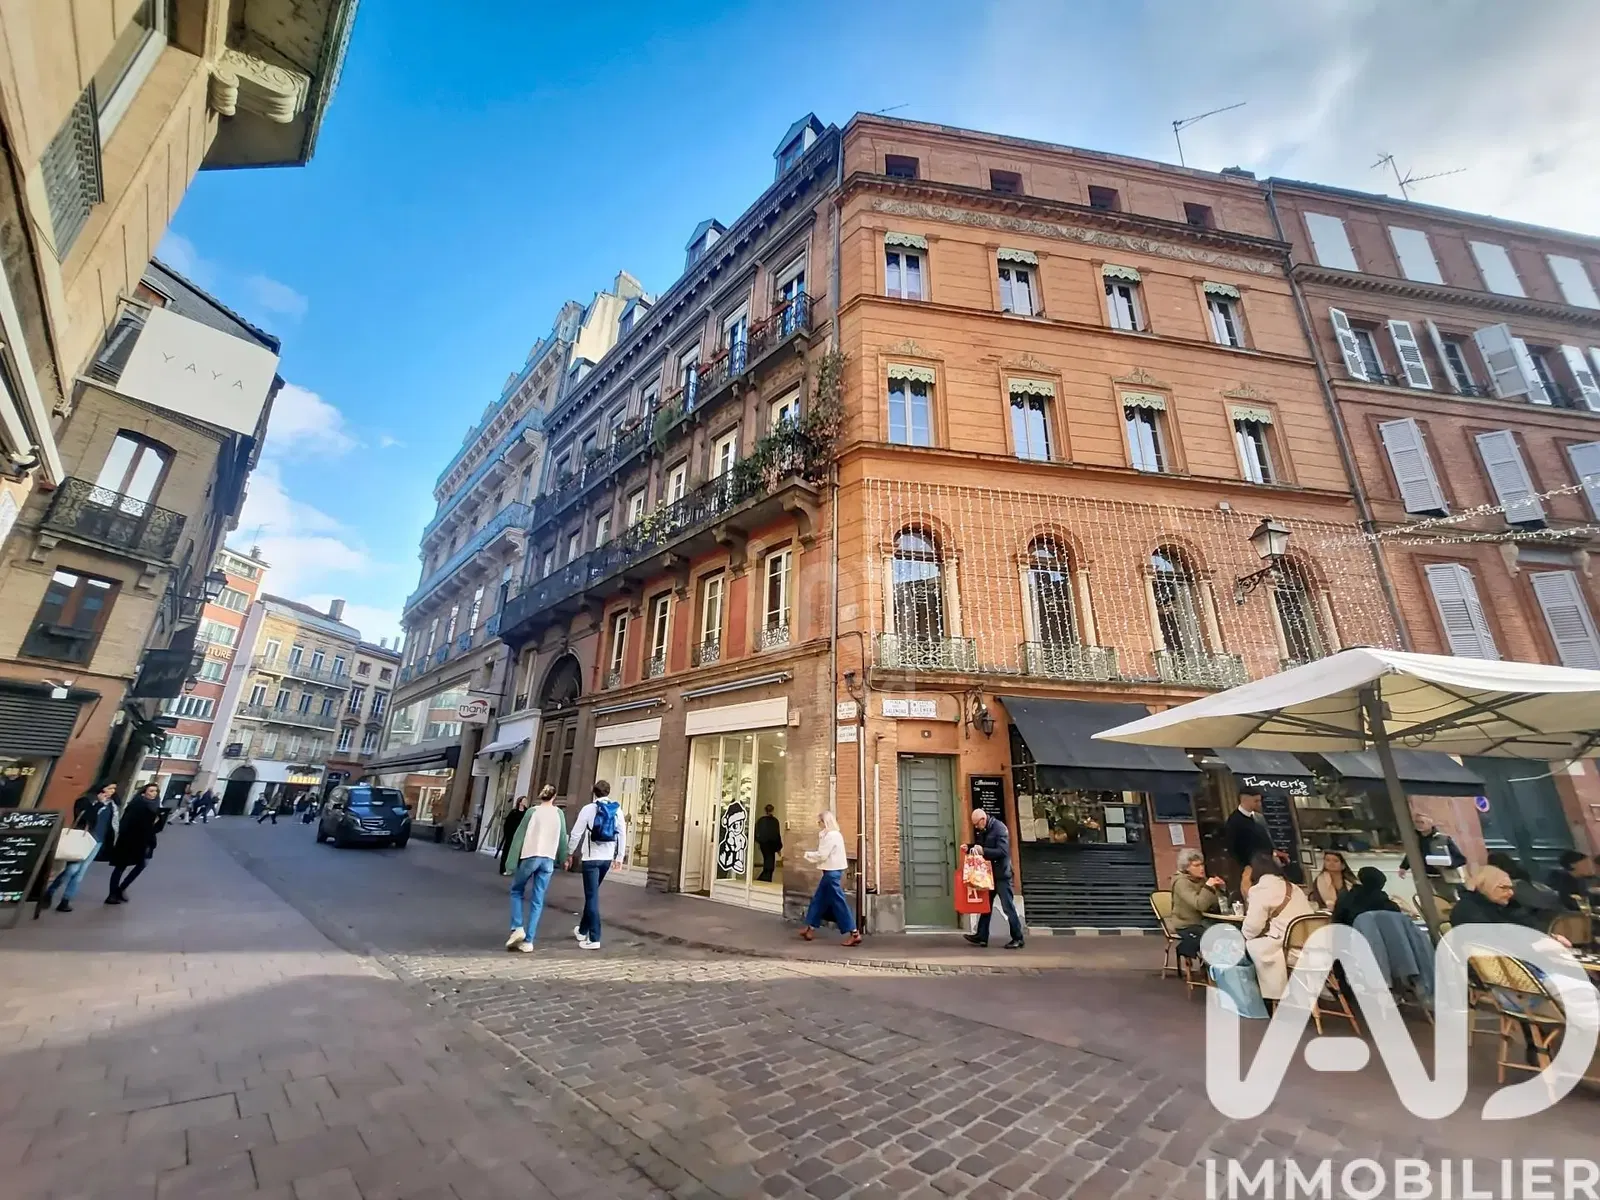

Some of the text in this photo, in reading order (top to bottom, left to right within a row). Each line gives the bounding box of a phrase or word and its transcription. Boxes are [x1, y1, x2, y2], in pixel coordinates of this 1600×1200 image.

[162, 351, 245, 391] YAYA
[459, 703, 488, 715] mank
[21, 766, 36, 776] 52
